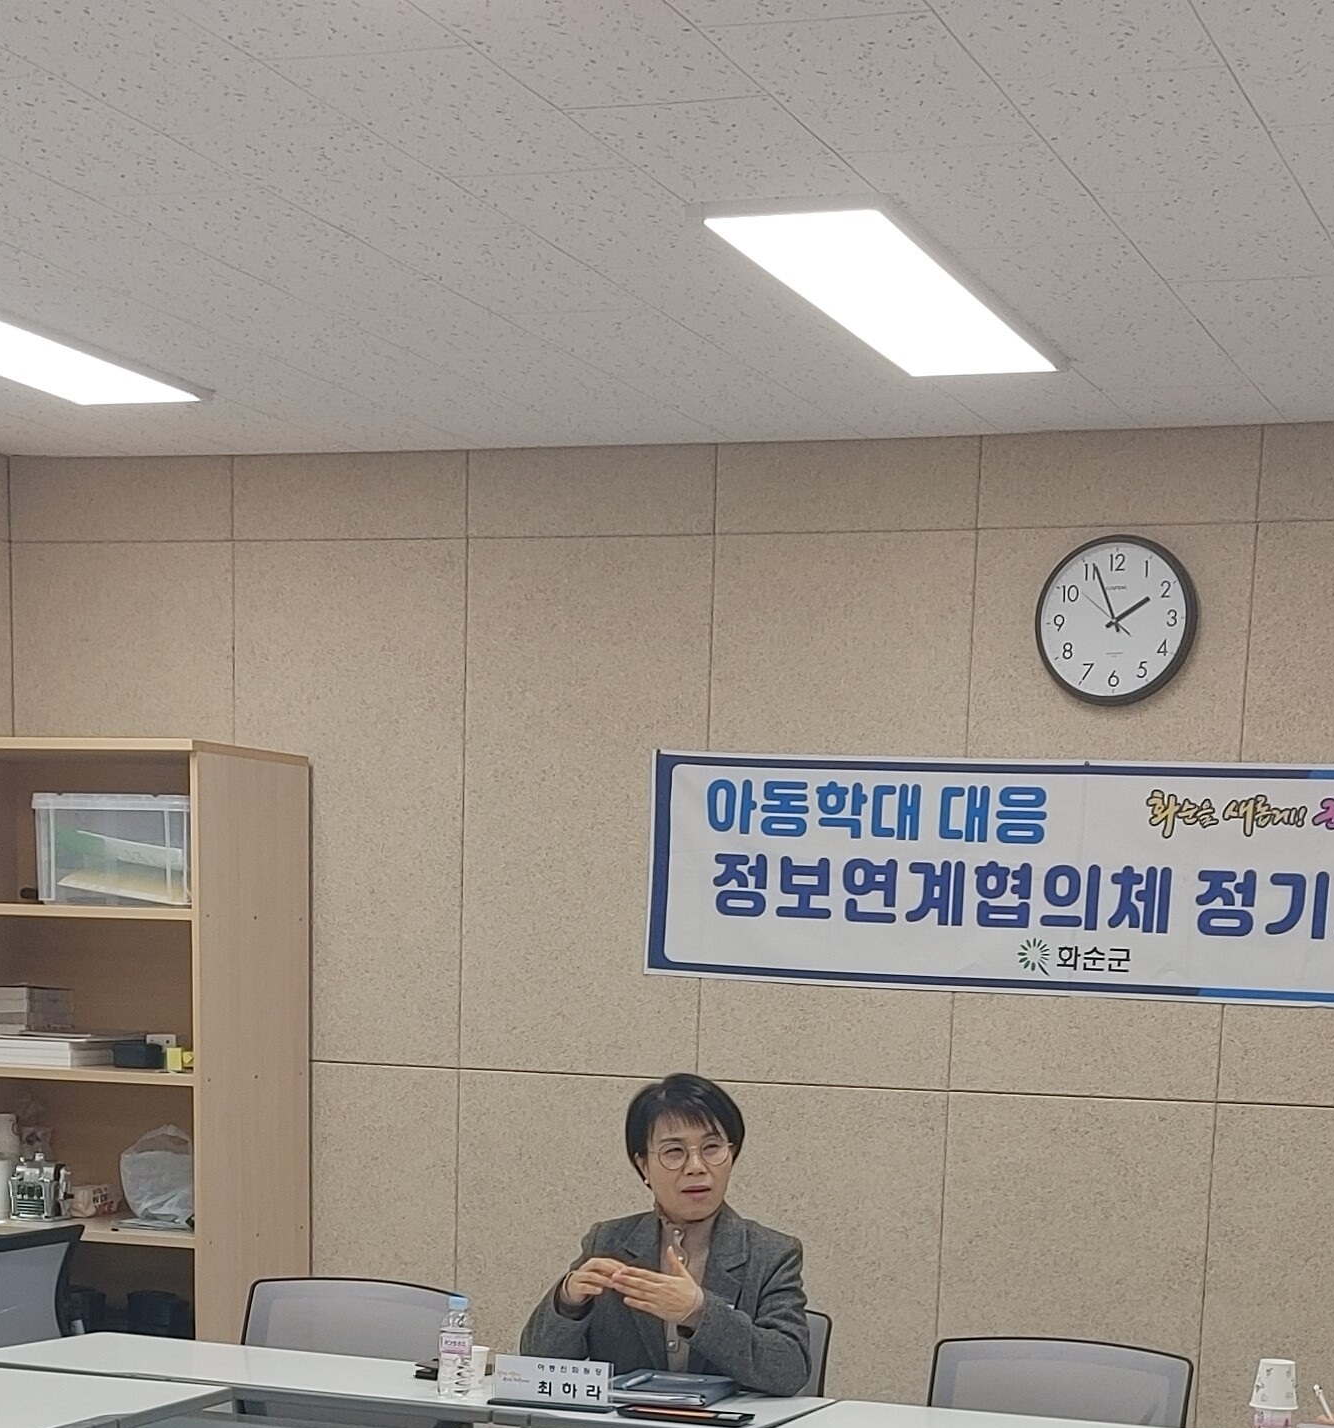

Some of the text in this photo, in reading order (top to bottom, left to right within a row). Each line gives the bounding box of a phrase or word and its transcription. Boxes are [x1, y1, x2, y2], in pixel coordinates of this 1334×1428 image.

[1110, 553, 1126, 571] 12
[1084, 563, 1096, 581] 11
[1062, 585, 1079, 603] 10
[1160, 580, 1171, 598] 2
[1053, 614, 1065, 632] 9
[1166, 609, 1177, 627] 3
[1062, 642, 1073, 660] 8
[1157, 639, 1168, 656] 4
[1082, 663, 1094, 680] 7
[1136, 661, 1148, 678] 5
[1107, 670, 1120, 688] 6
[706, 778, 1048, 845] 아동학대 대응
[1146, 789, 1219, 838] 화순을
[1222, 794, 1308, 837] 새롭게!
[712, 852, 1173, 934] 정보연계협의체
[1056, 945, 1132, 973] 화순군
